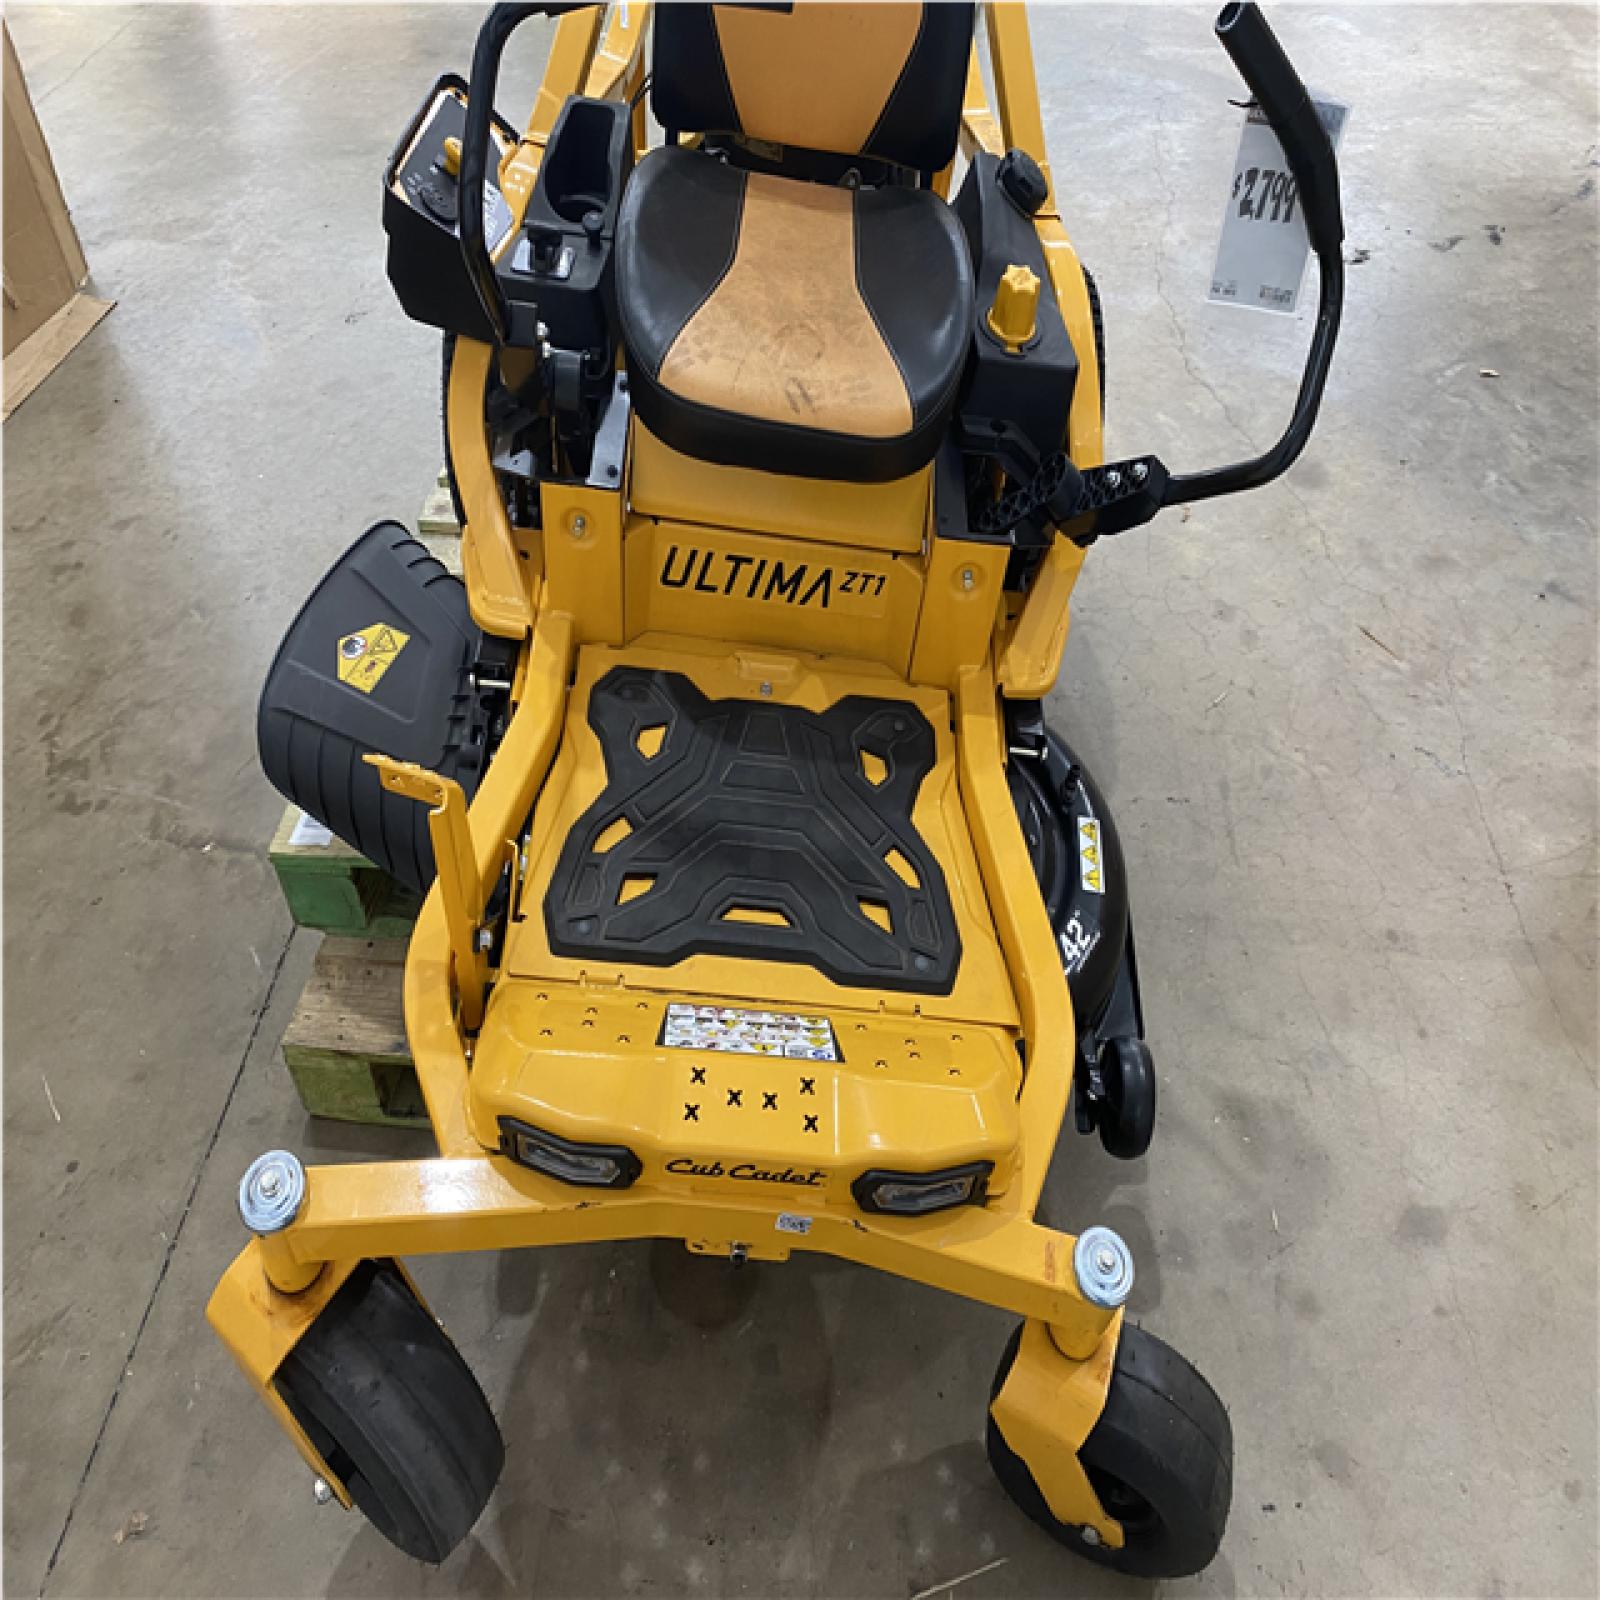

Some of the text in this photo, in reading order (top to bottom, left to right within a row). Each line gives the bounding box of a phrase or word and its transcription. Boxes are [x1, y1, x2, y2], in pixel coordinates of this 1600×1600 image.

[660, 544, 886, 609] ULTIMA ZT1
[664, 1159, 827, 1186] Cub Cadet
